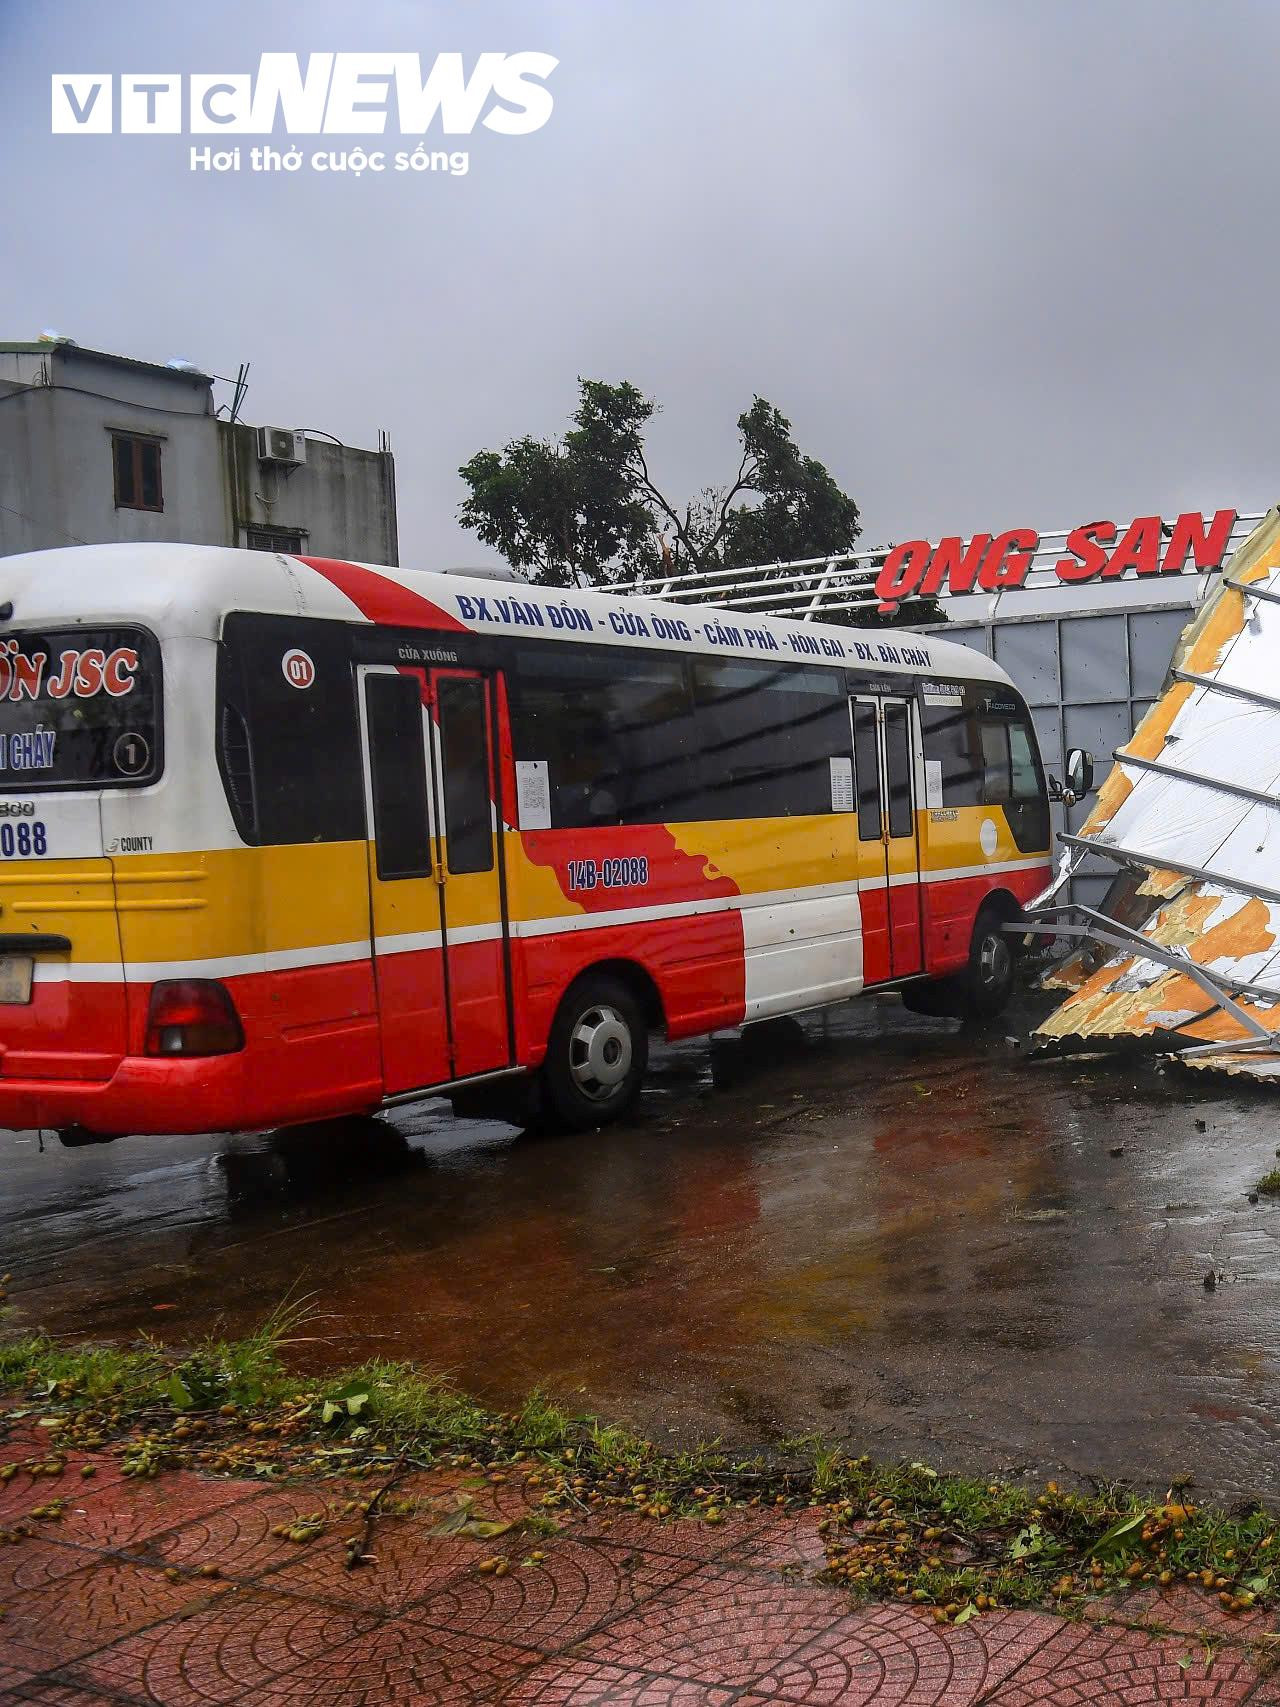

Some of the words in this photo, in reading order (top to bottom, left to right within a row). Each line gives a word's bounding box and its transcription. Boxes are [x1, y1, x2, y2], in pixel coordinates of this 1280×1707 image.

[547, 598, 594, 632] ĐỒN
[608, 606, 651, 638] CỬA
[651, 612, 693, 642] ÔNG
[743, 624, 780, 651] PHẢ
[786, 629, 821, 656] HÒN
[819, 637, 846, 658] GAI
[900, 646, 932, 668] CHÁY
[398, 645, 420, 661] CỬA
[423, 648, 458, 663] XUỐNG
[47, 647, 139, 698] JSC
[290, 660, 310, 681] 01
[10, 724, 56, 771] CHÁY
[124, 743, 136, 765] 1
[120, 836, 153, 852] COUNTY
[568, 856, 649, 891] 14B-02088
